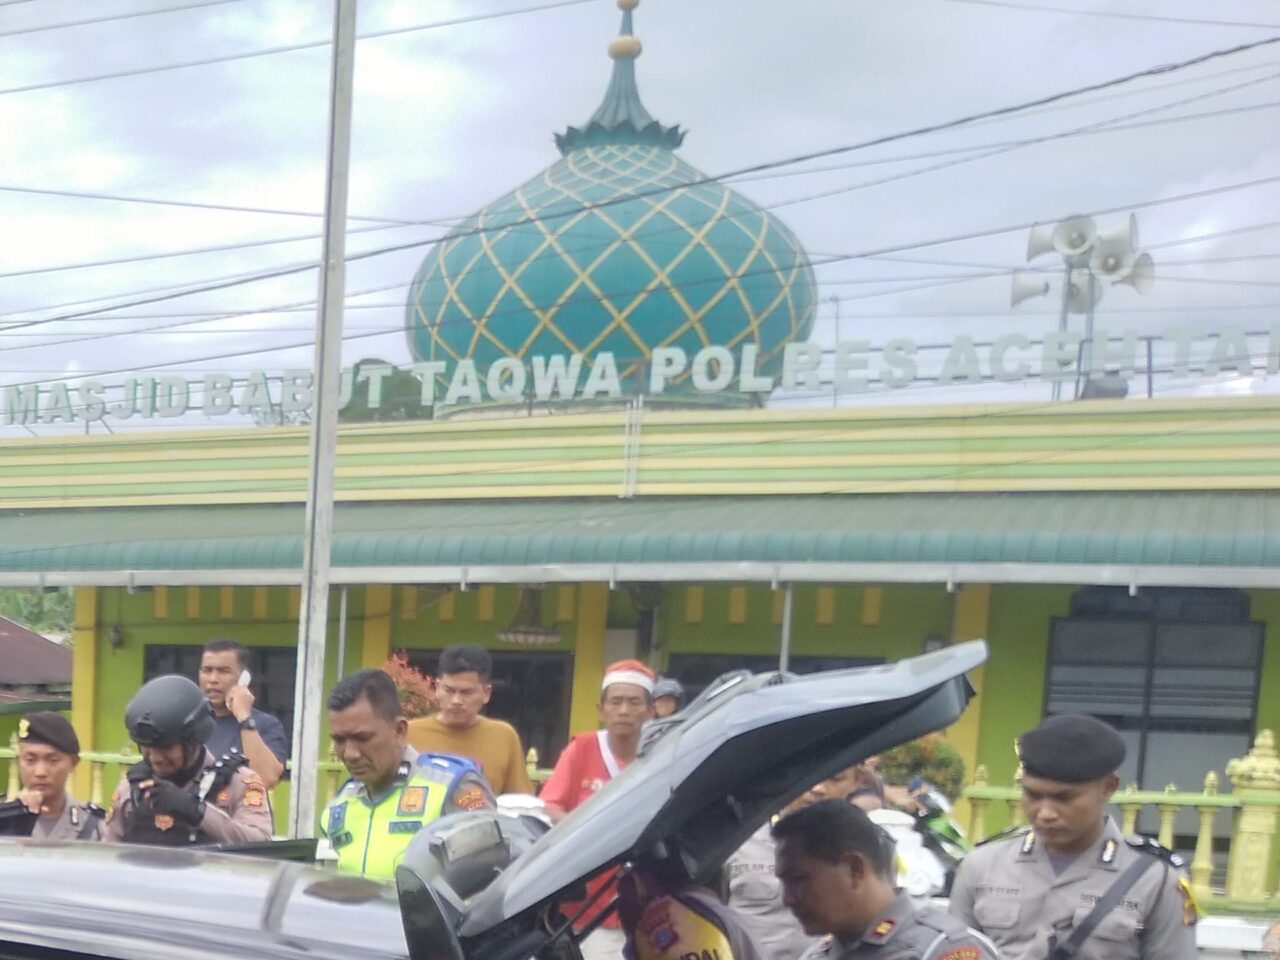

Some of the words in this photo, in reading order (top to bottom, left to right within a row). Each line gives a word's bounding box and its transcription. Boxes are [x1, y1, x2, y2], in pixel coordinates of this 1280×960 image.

[4, 375, 190, 426] MASJID
[410, 352, 621, 406] TAQWA
[649, 338, 918, 393] POLRES
[935, 329, 1140, 384] ACEH
